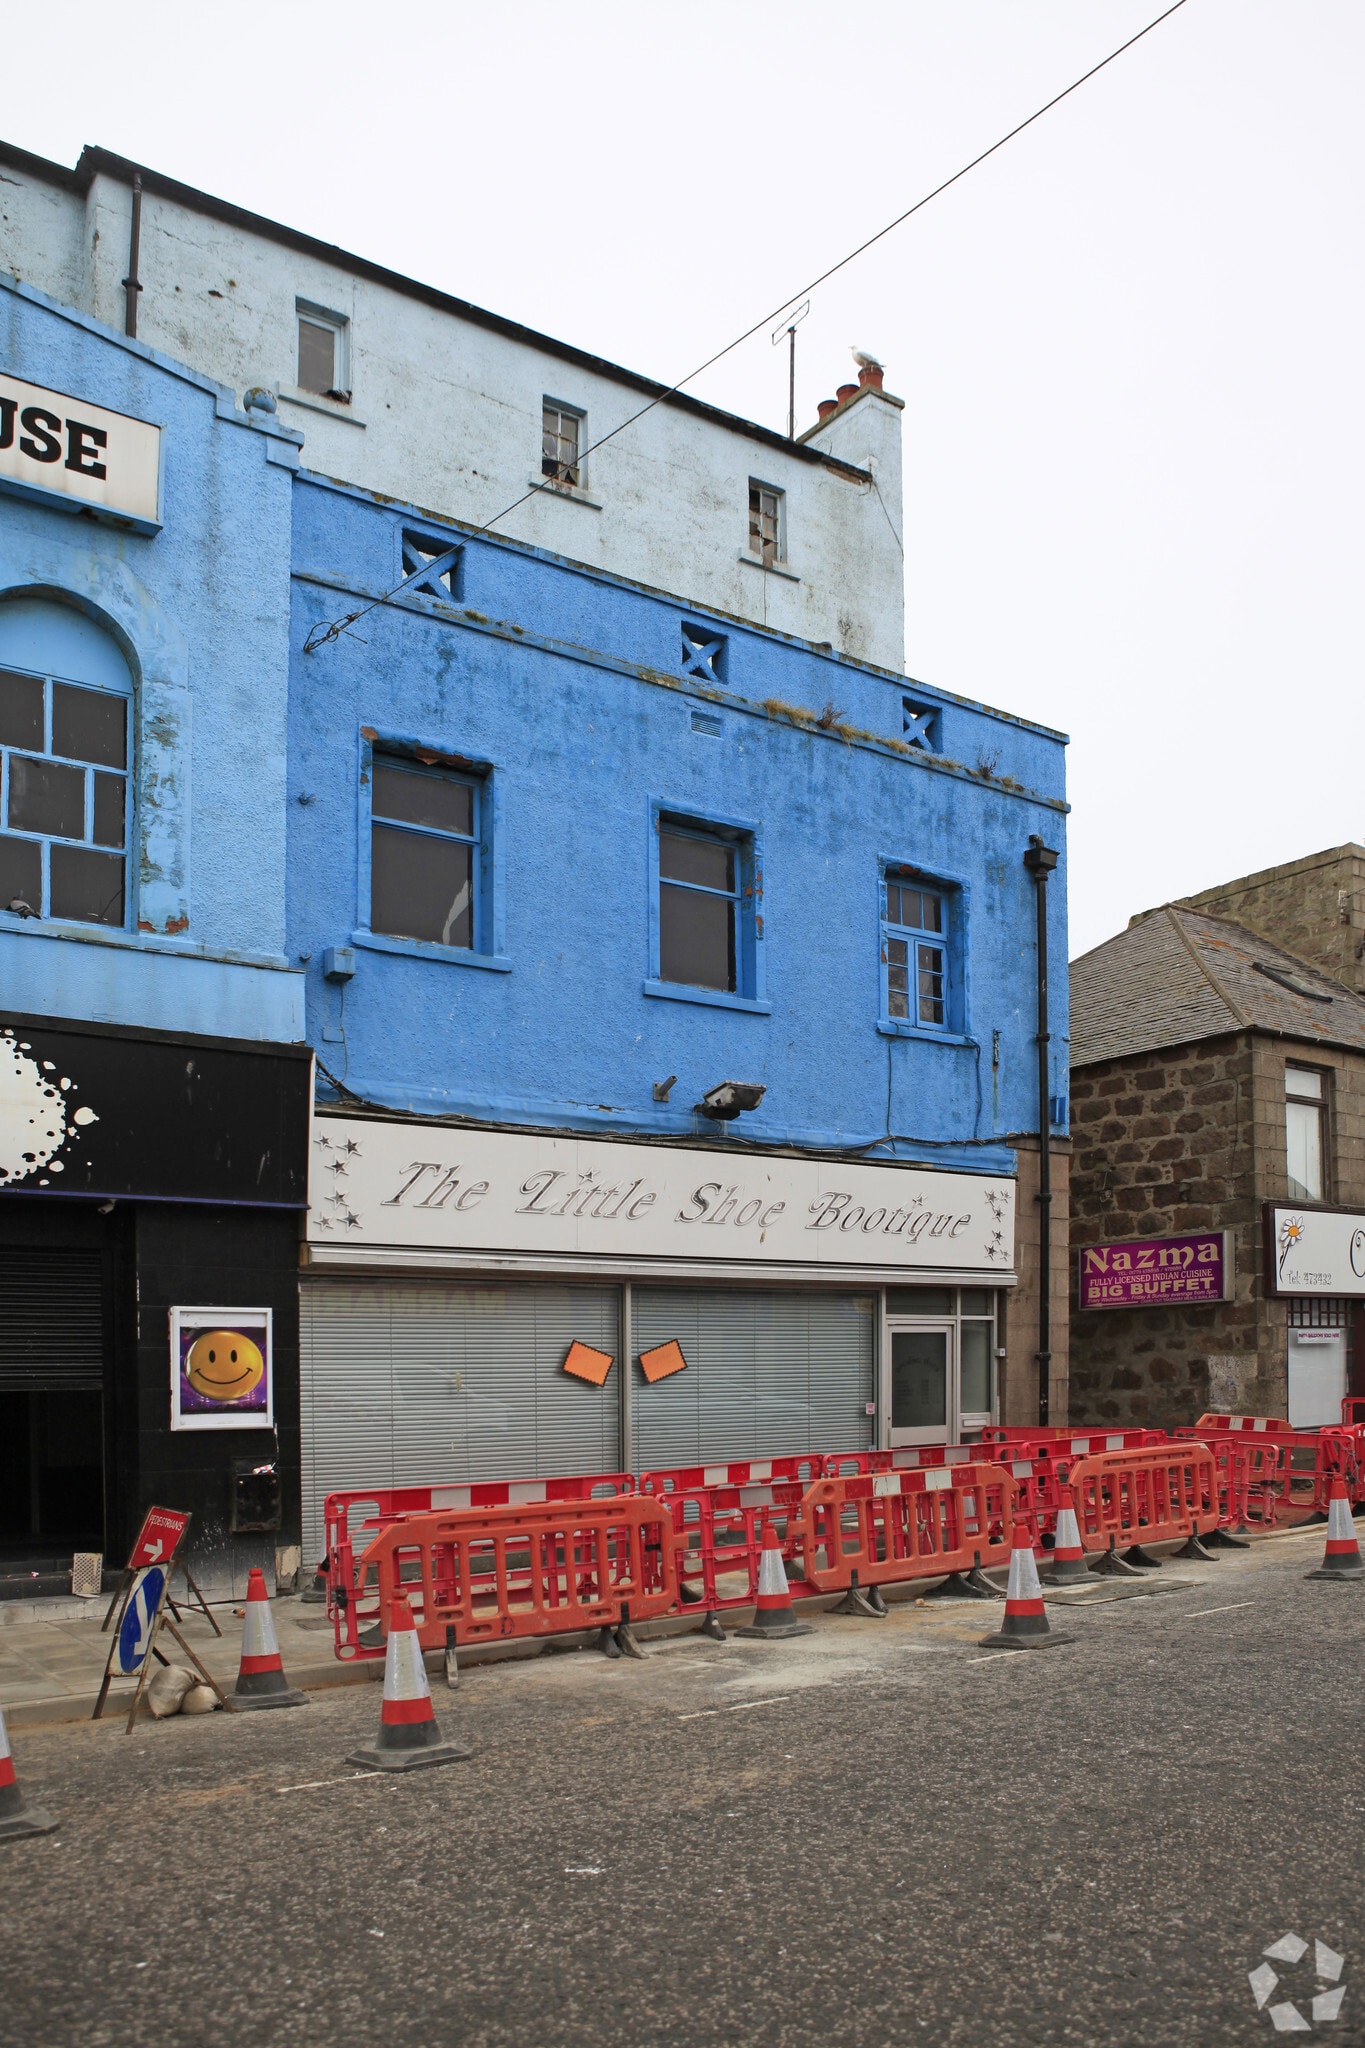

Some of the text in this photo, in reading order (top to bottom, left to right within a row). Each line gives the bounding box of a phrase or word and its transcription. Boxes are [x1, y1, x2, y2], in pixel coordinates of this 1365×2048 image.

[379, 1160, 974, 1244] The Little Shoe Bootique
[1083, 1243, 1220, 1274] Nazma
[1088, 1277, 1215, 1298] BIG BUFFET
[1090, 1277, 1114, 1286] FULLY
[1114, 1274, 1150, 1284] LICENSED
[1152, 1272, 1179, 1280] INDIAN
[1180, 1268, 1213, 1278] CUISINE
[150, 1514, 184, 1531] PEDESTRIANS
